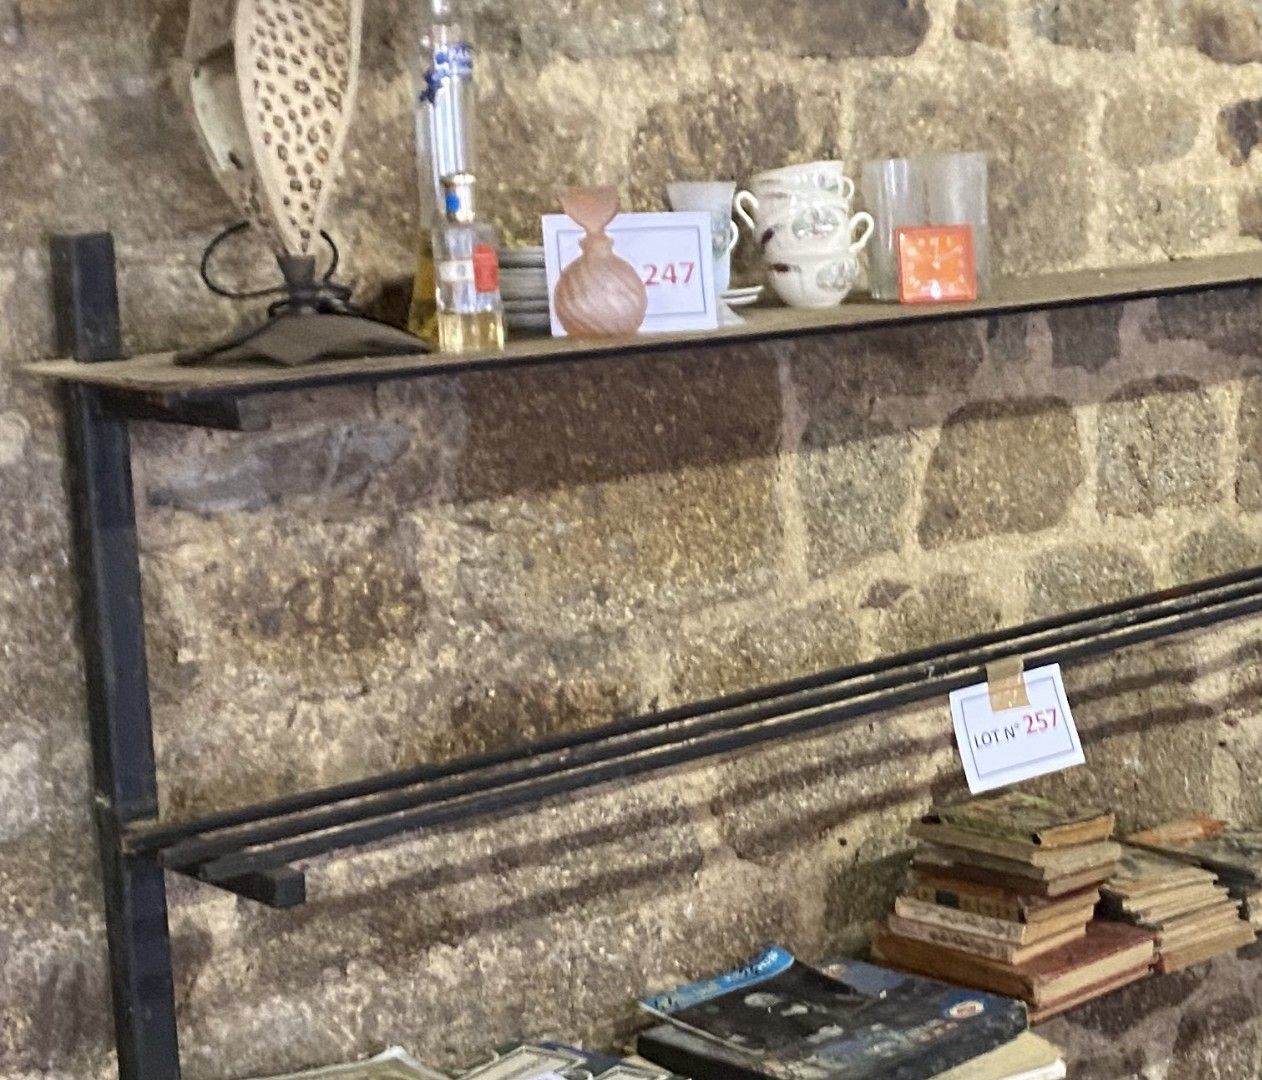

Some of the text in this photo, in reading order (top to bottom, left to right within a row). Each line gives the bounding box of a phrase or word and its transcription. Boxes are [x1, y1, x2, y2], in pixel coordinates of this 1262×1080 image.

[642, 261, 696, 287] 247
[973, 706, 1058, 750] LOT N° 257
